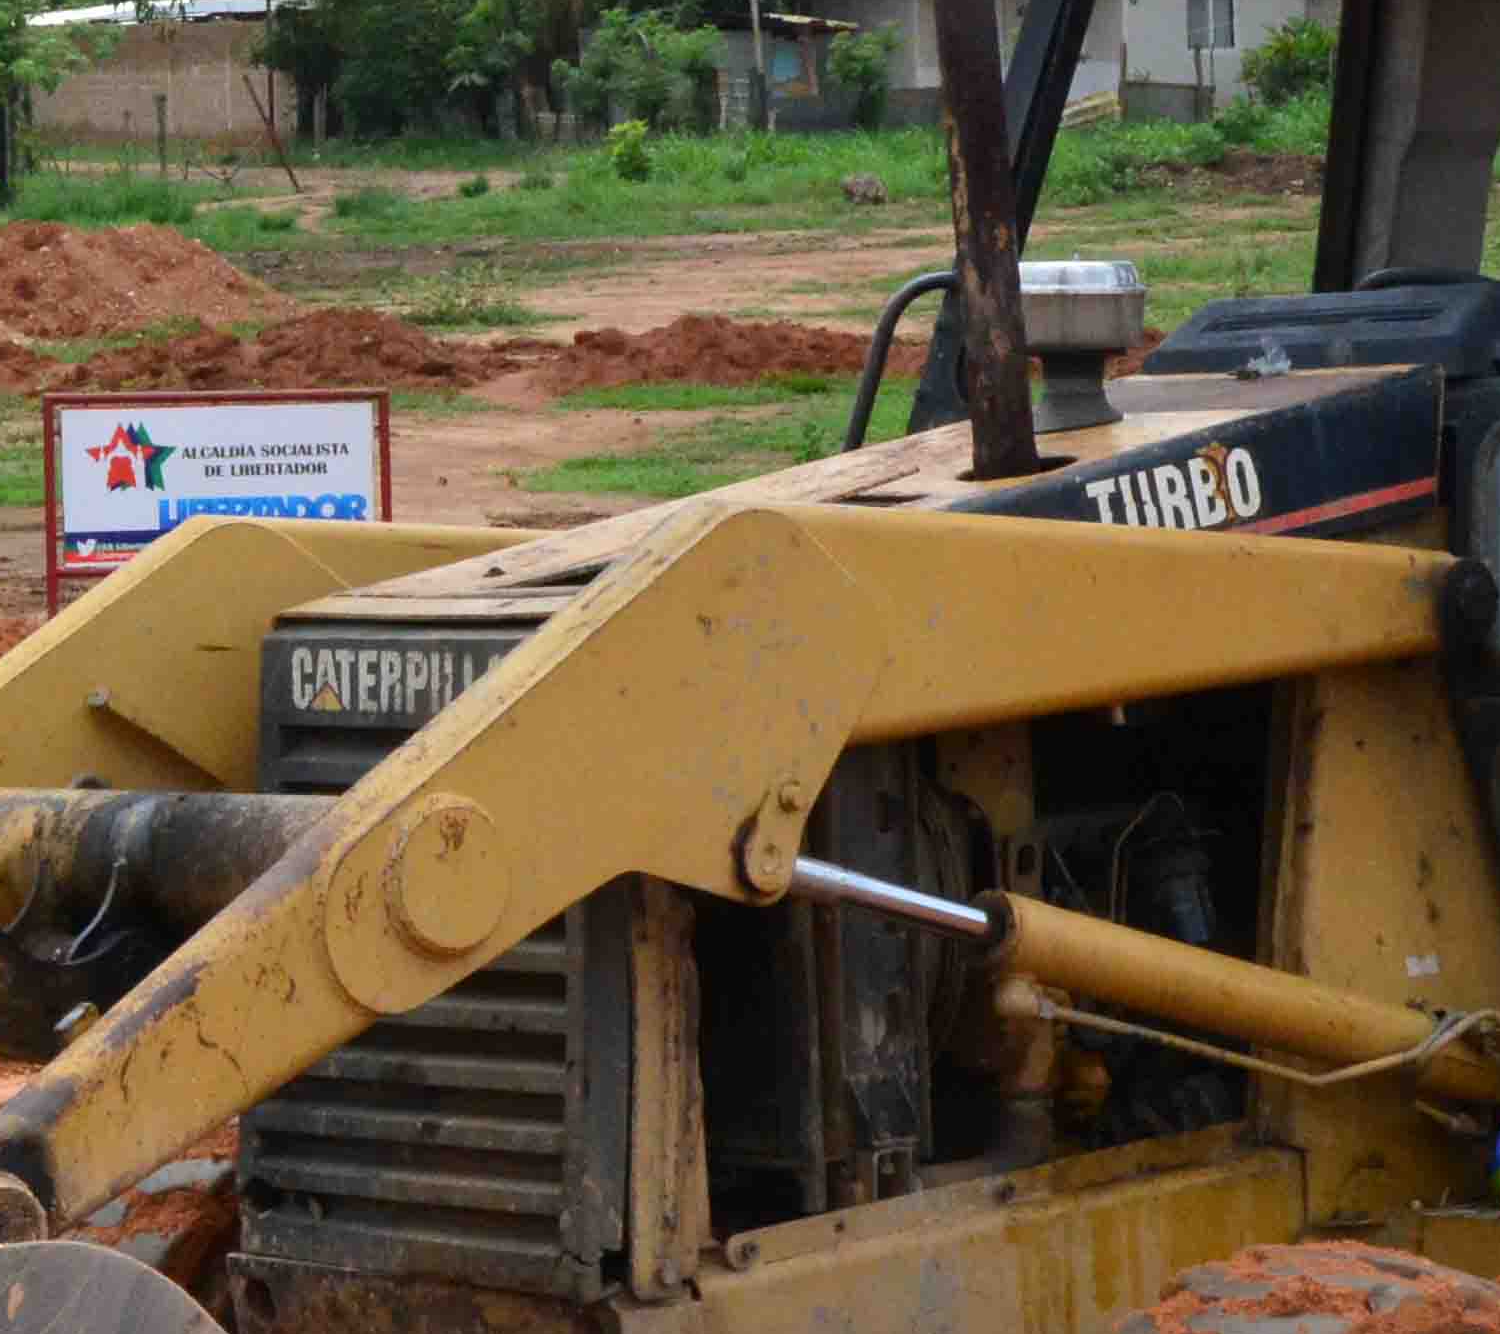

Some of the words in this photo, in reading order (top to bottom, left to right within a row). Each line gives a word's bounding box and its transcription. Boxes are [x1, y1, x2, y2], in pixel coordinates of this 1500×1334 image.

[261, 441, 350, 458] SOCIALISTA
[204, 464, 226, 478] DE
[230, 462, 328, 477] LIBERTADOR
[1085, 446, 1261, 531] TURBO
